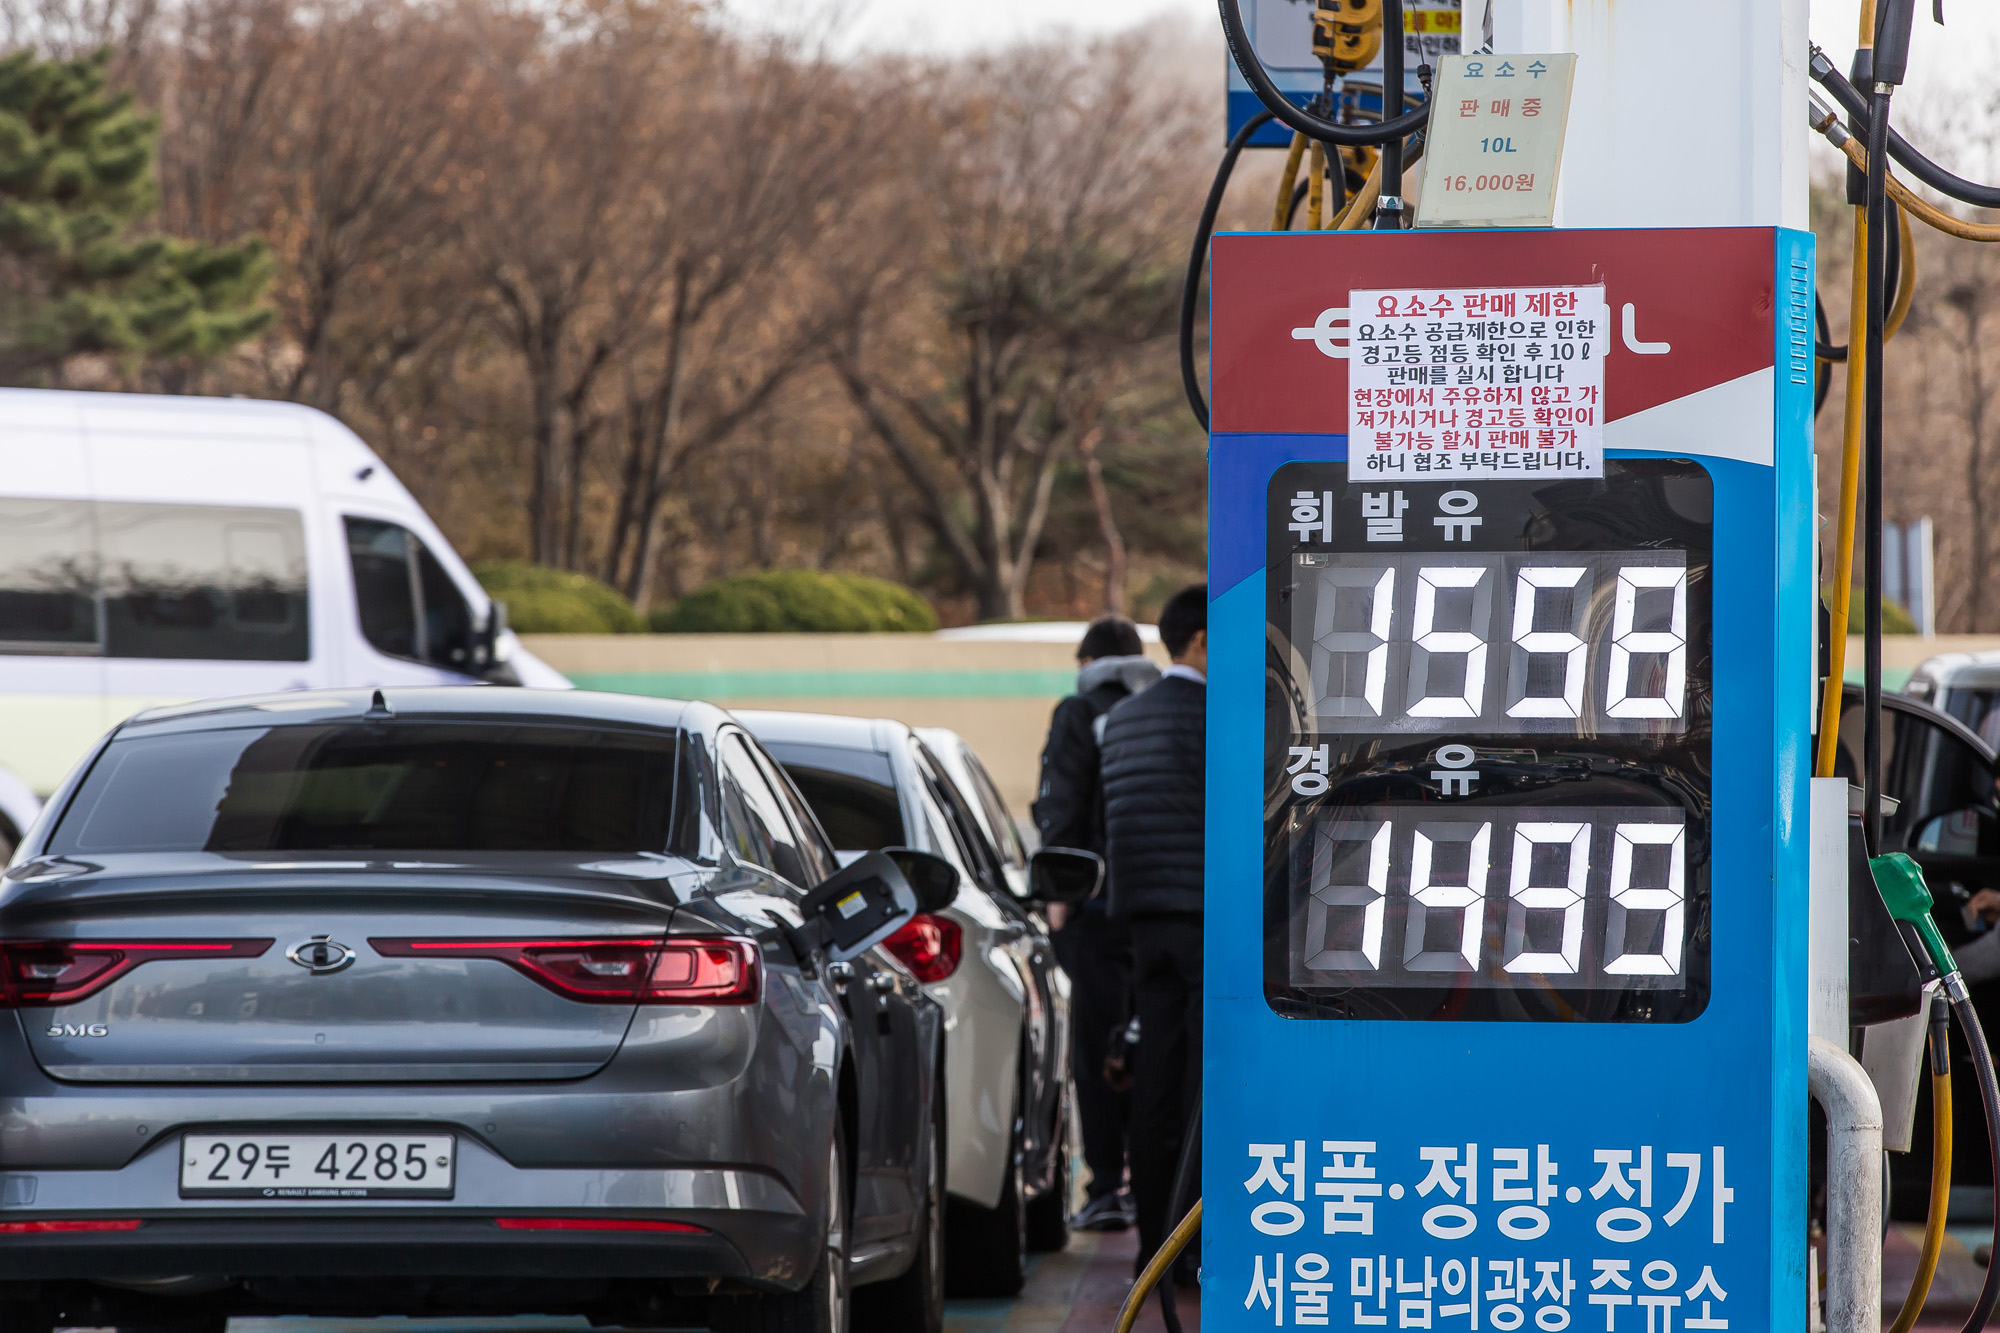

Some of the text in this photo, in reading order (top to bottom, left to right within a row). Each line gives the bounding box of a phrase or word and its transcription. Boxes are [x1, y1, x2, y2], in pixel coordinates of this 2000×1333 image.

[1463, 60, 1547, 79] 요소수
[1460, 98, 1542, 118] 판매중
[1480, 137, 1517, 153] 10L
[1443, 173, 1535, 193] 16,000원
[1375, 291, 1579, 318] 요소수 판매 제한
[1357, 320, 1597, 342] 요소수 공급제한으로 인한
[1361, 345, 1423, 364] 경고등
[1429, 344, 1470, 363] 점등
[1475, 343, 1516, 362] 확인
[1523, 342, 1544, 361] 후
[1387, 364, 1565, 385] 판매를 실시 합니다
[1353, 385, 1599, 407] 현장에서 주유하지 않고 가
[1355, 407, 1594, 429] 져가시거나 경고등 확인이
[1374, 429, 1578, 451] 불가능 할시 판매 불가
[1366, 451, 1590, 472] 하니 협조 부탁드립니다.
[1364, 566, 1687, 719] 1558
[1361, 820, 1686, 976] 1499
[207, 1142, 427, 1181] 29두 4285
[1243, 1252, 1334, 1327] 서울
[1587, 1258, 1730, 1333] 주유소
